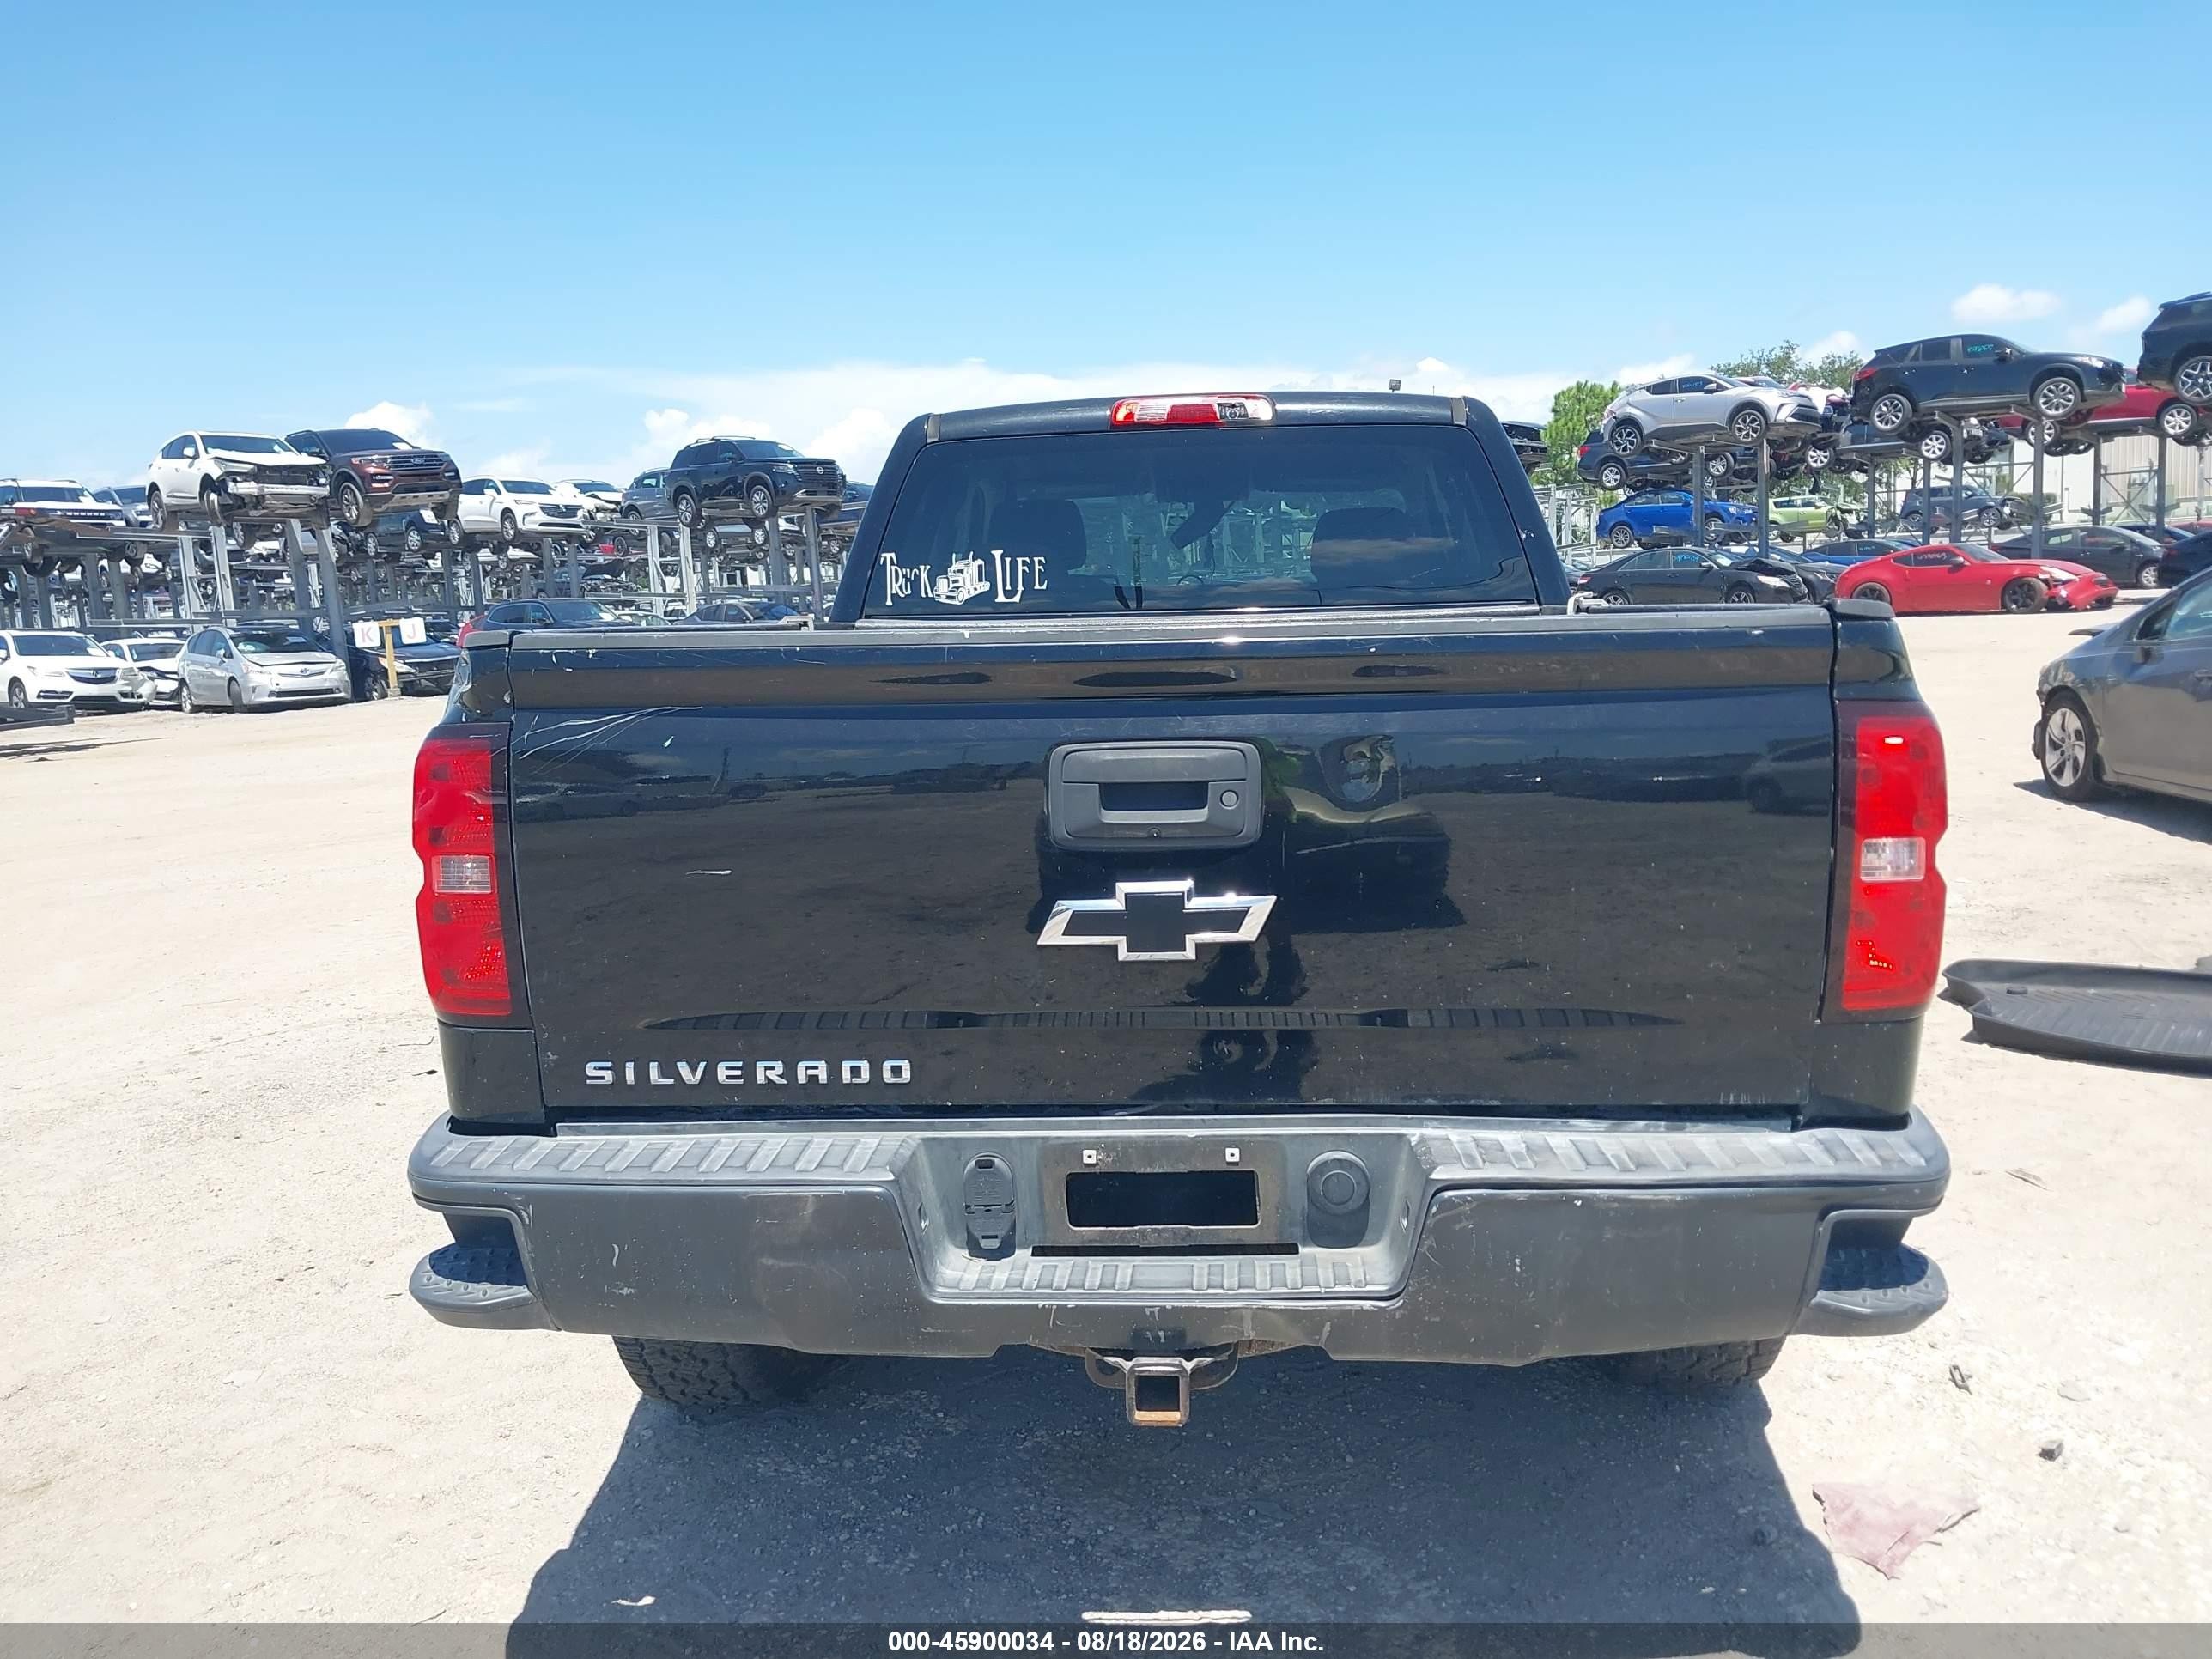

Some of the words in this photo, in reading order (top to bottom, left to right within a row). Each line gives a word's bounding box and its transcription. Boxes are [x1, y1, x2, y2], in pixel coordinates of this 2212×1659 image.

[990, 550, 1048, 603] LIFE
[360, 627, 375, 642] K
[406, 623, 416, 639] J
[585, 1060, 913, 1085] SILVERADO
